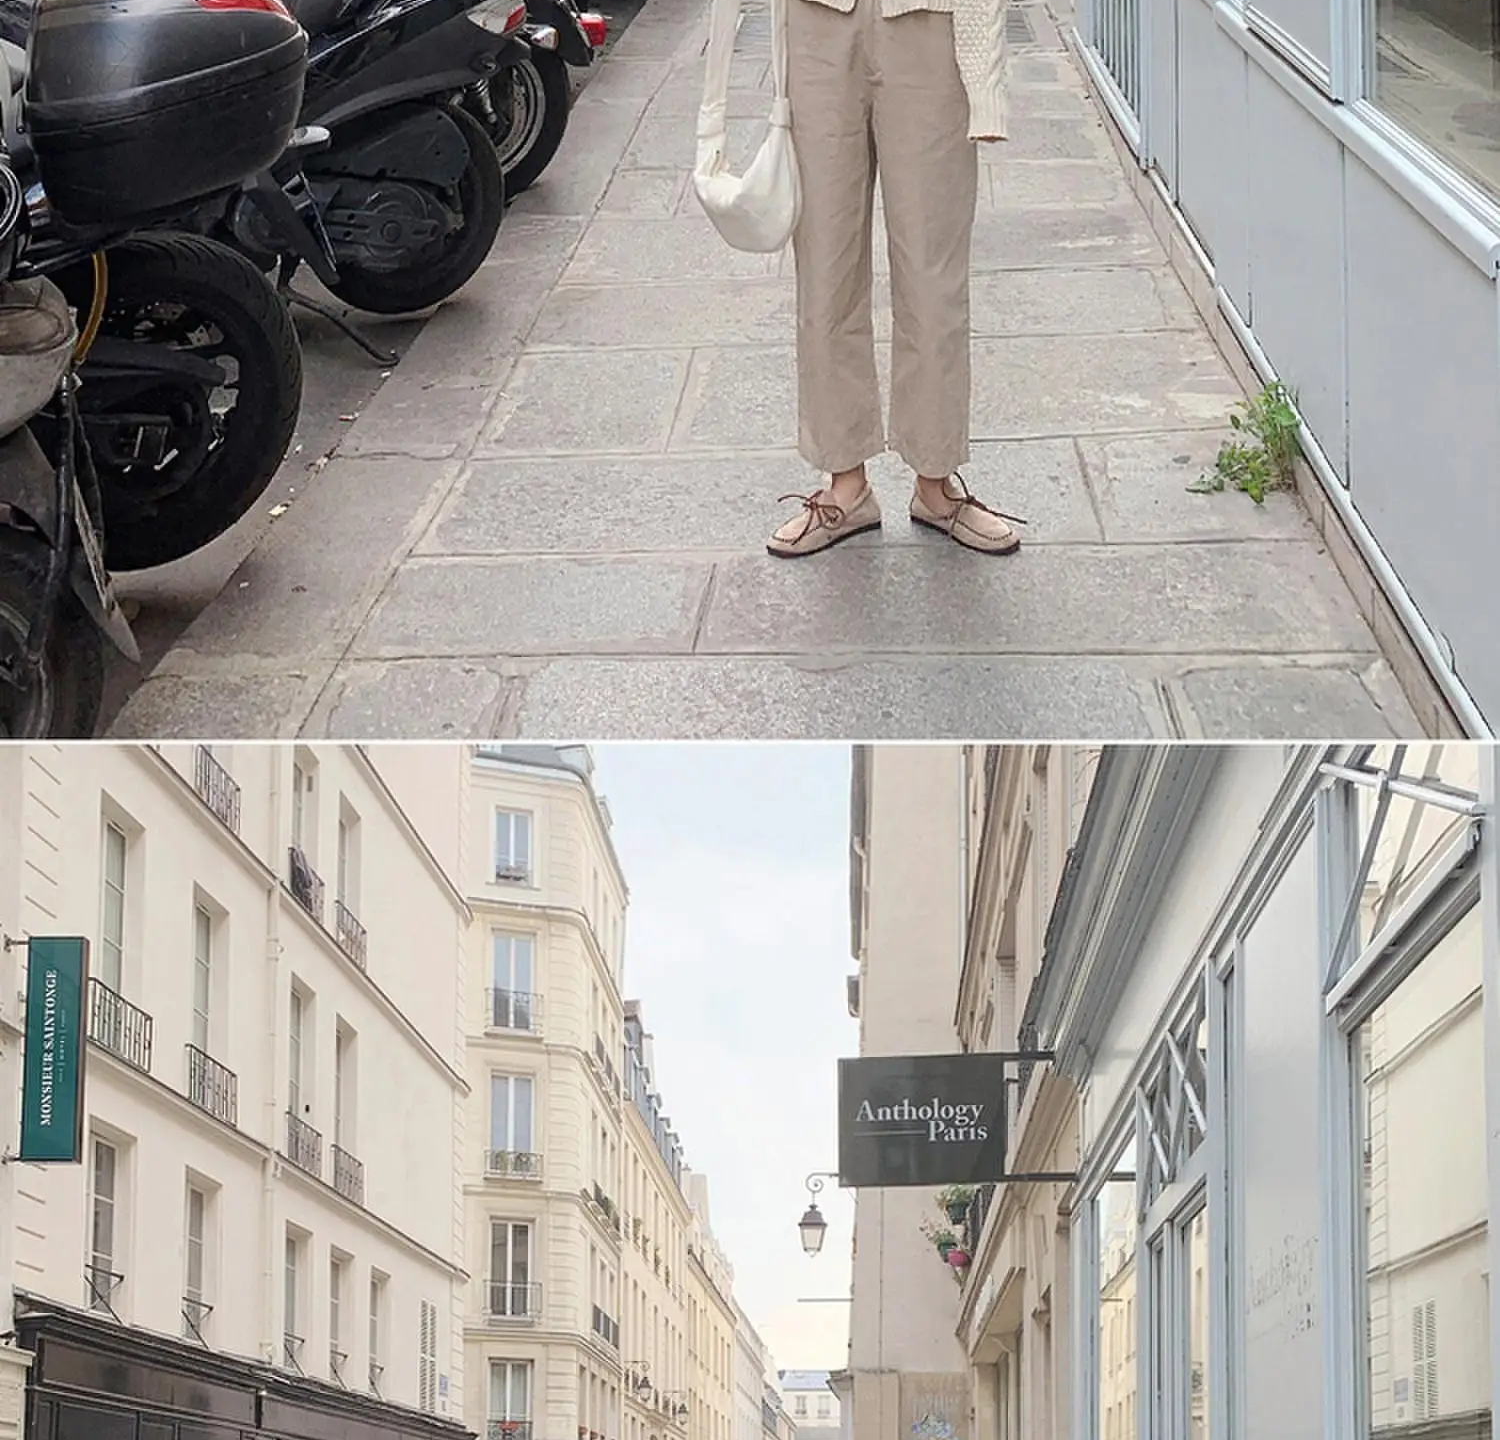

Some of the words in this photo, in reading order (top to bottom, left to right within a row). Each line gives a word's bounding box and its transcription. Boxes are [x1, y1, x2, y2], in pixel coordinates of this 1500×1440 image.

[43, 970, 57, 1049] SAINTONGE
[40, 1052, 54, 1126] MONSIEUR
[855, 1098, 984, 1125] Anthology
[928, 1120, 988, 1142] Paris
